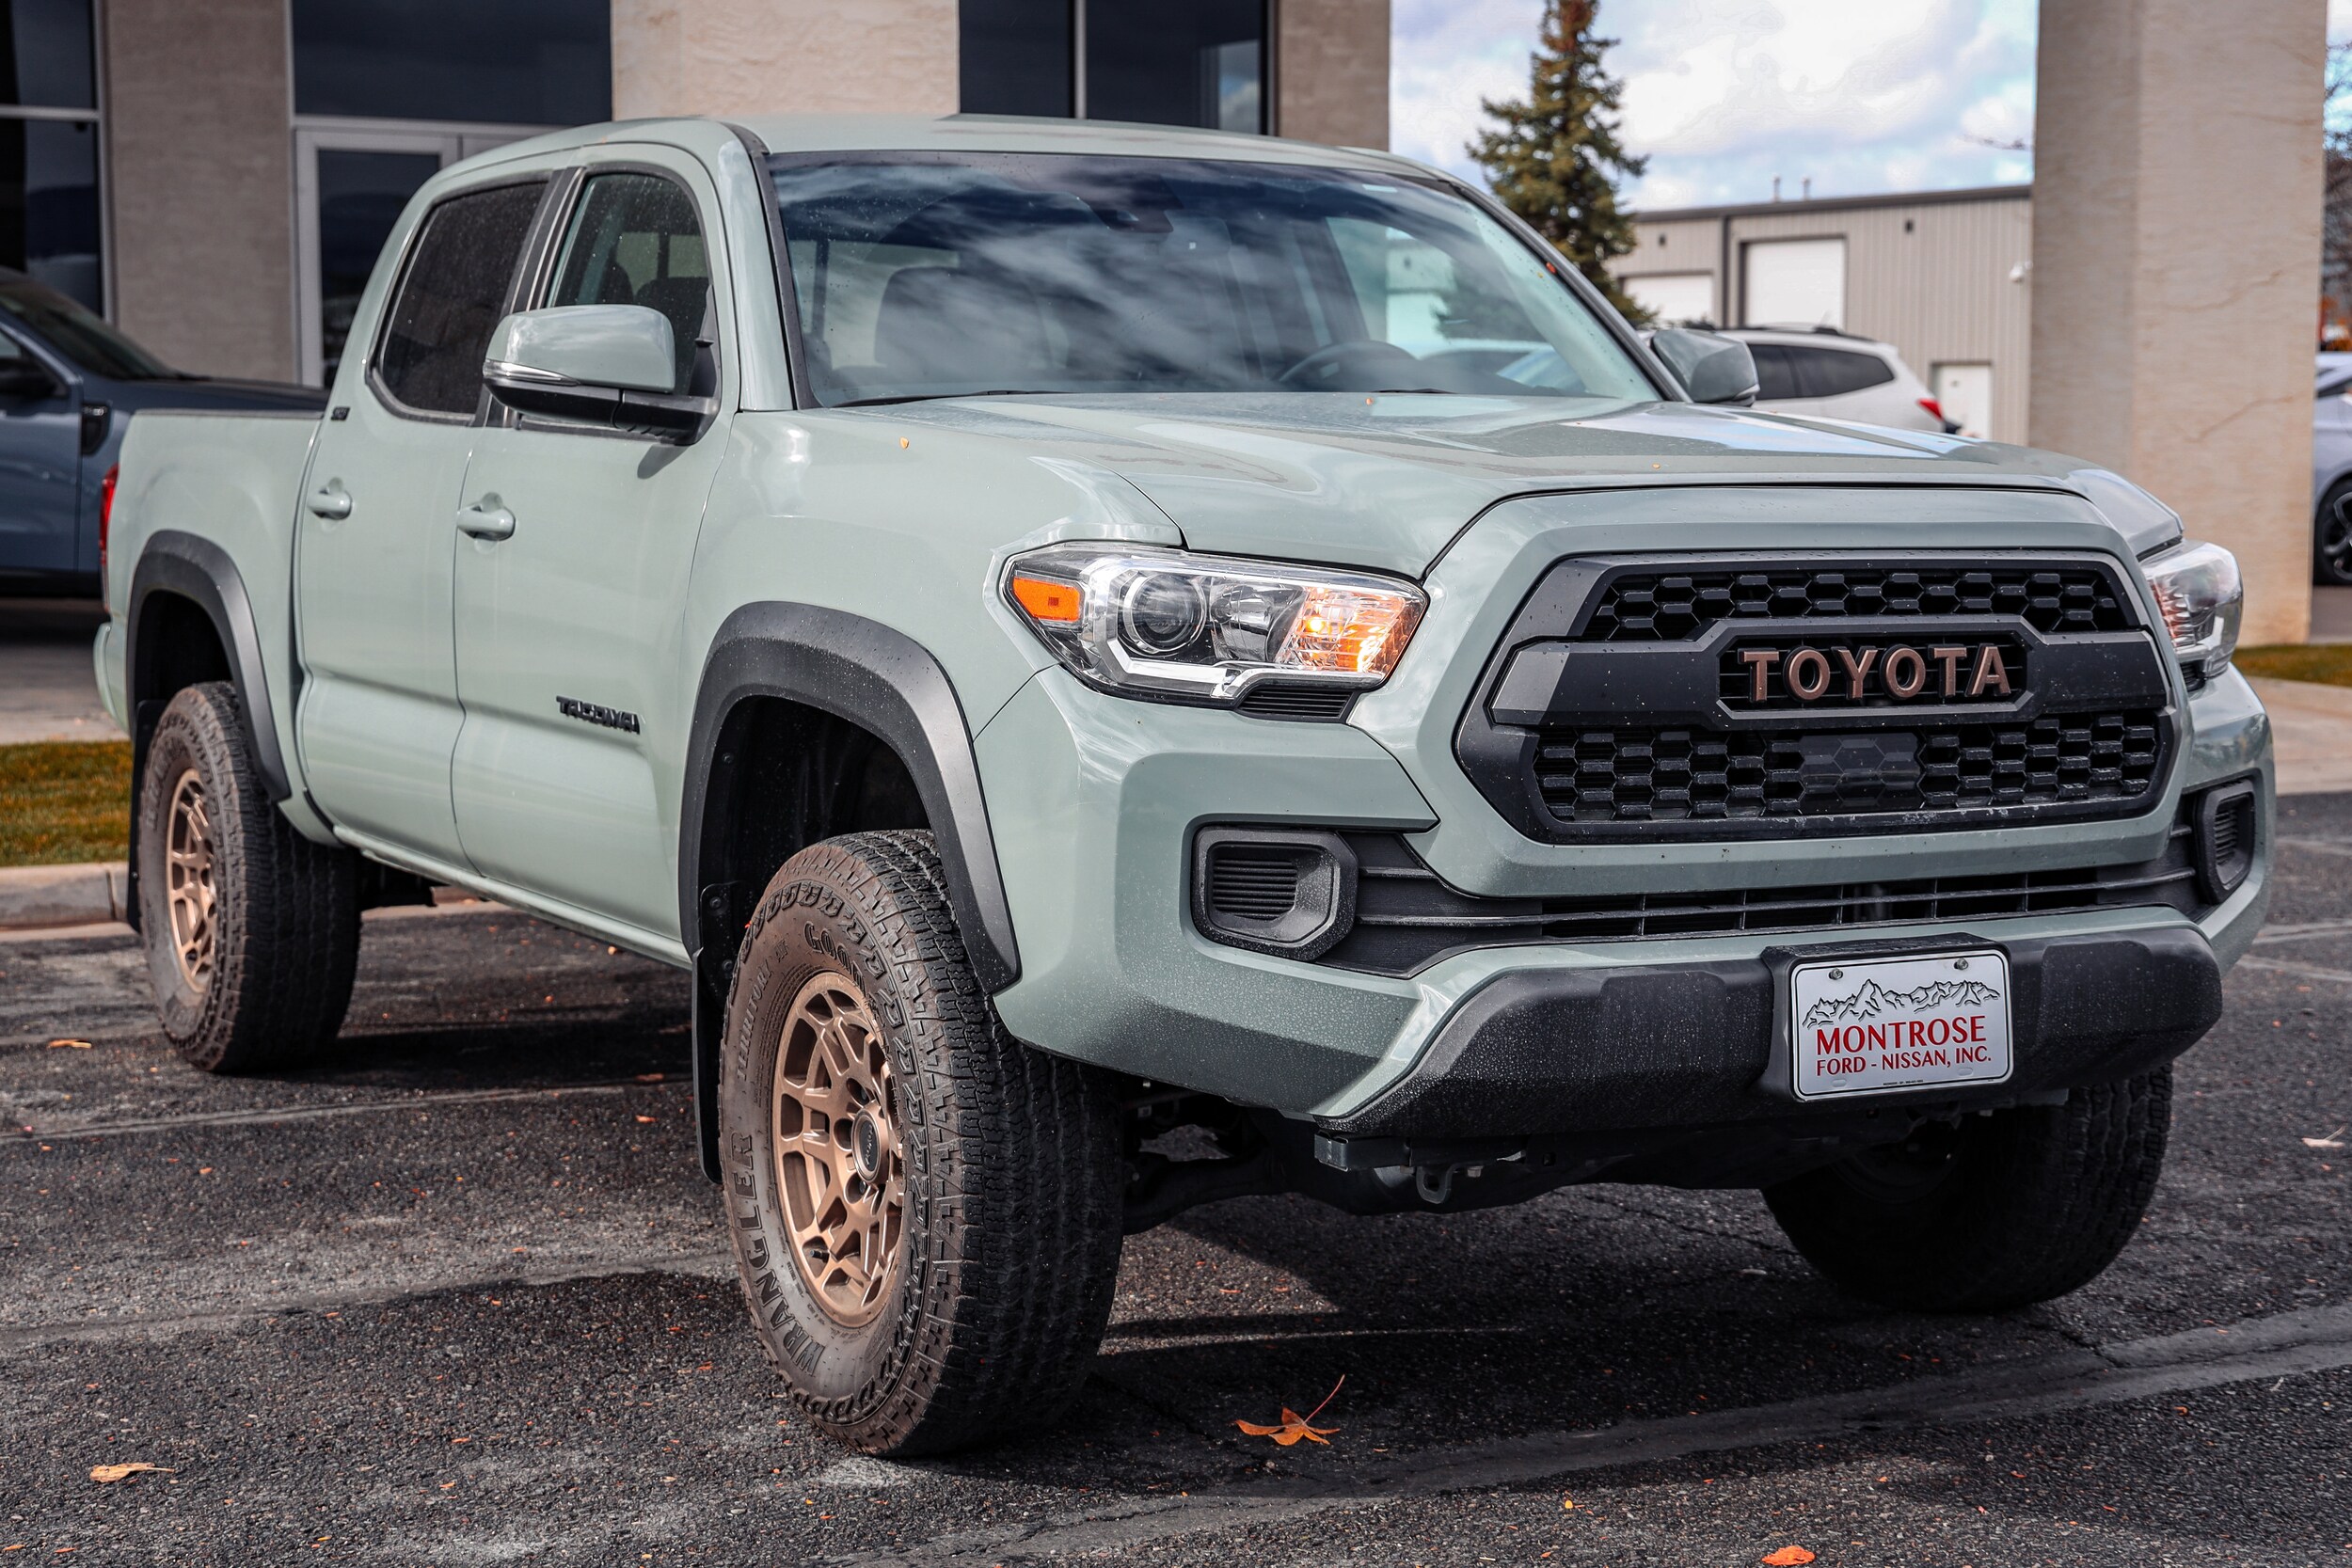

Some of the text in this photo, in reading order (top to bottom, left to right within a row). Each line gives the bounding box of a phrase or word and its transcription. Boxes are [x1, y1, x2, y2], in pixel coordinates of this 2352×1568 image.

[1740, 644, 2011, 703] TOYOTA
[737, 958, 774, 1081] TERRITORY
[1817, 1015, 1986, 1055] MONTROSE
[1816, 1056, 1866, 1076] FORD
[1882, 1049, 1951, 1070] NISSAN,
[1955, 1046, 1992, 1064] INC.
[731, 1132, 825, 1375] WRANGLER
